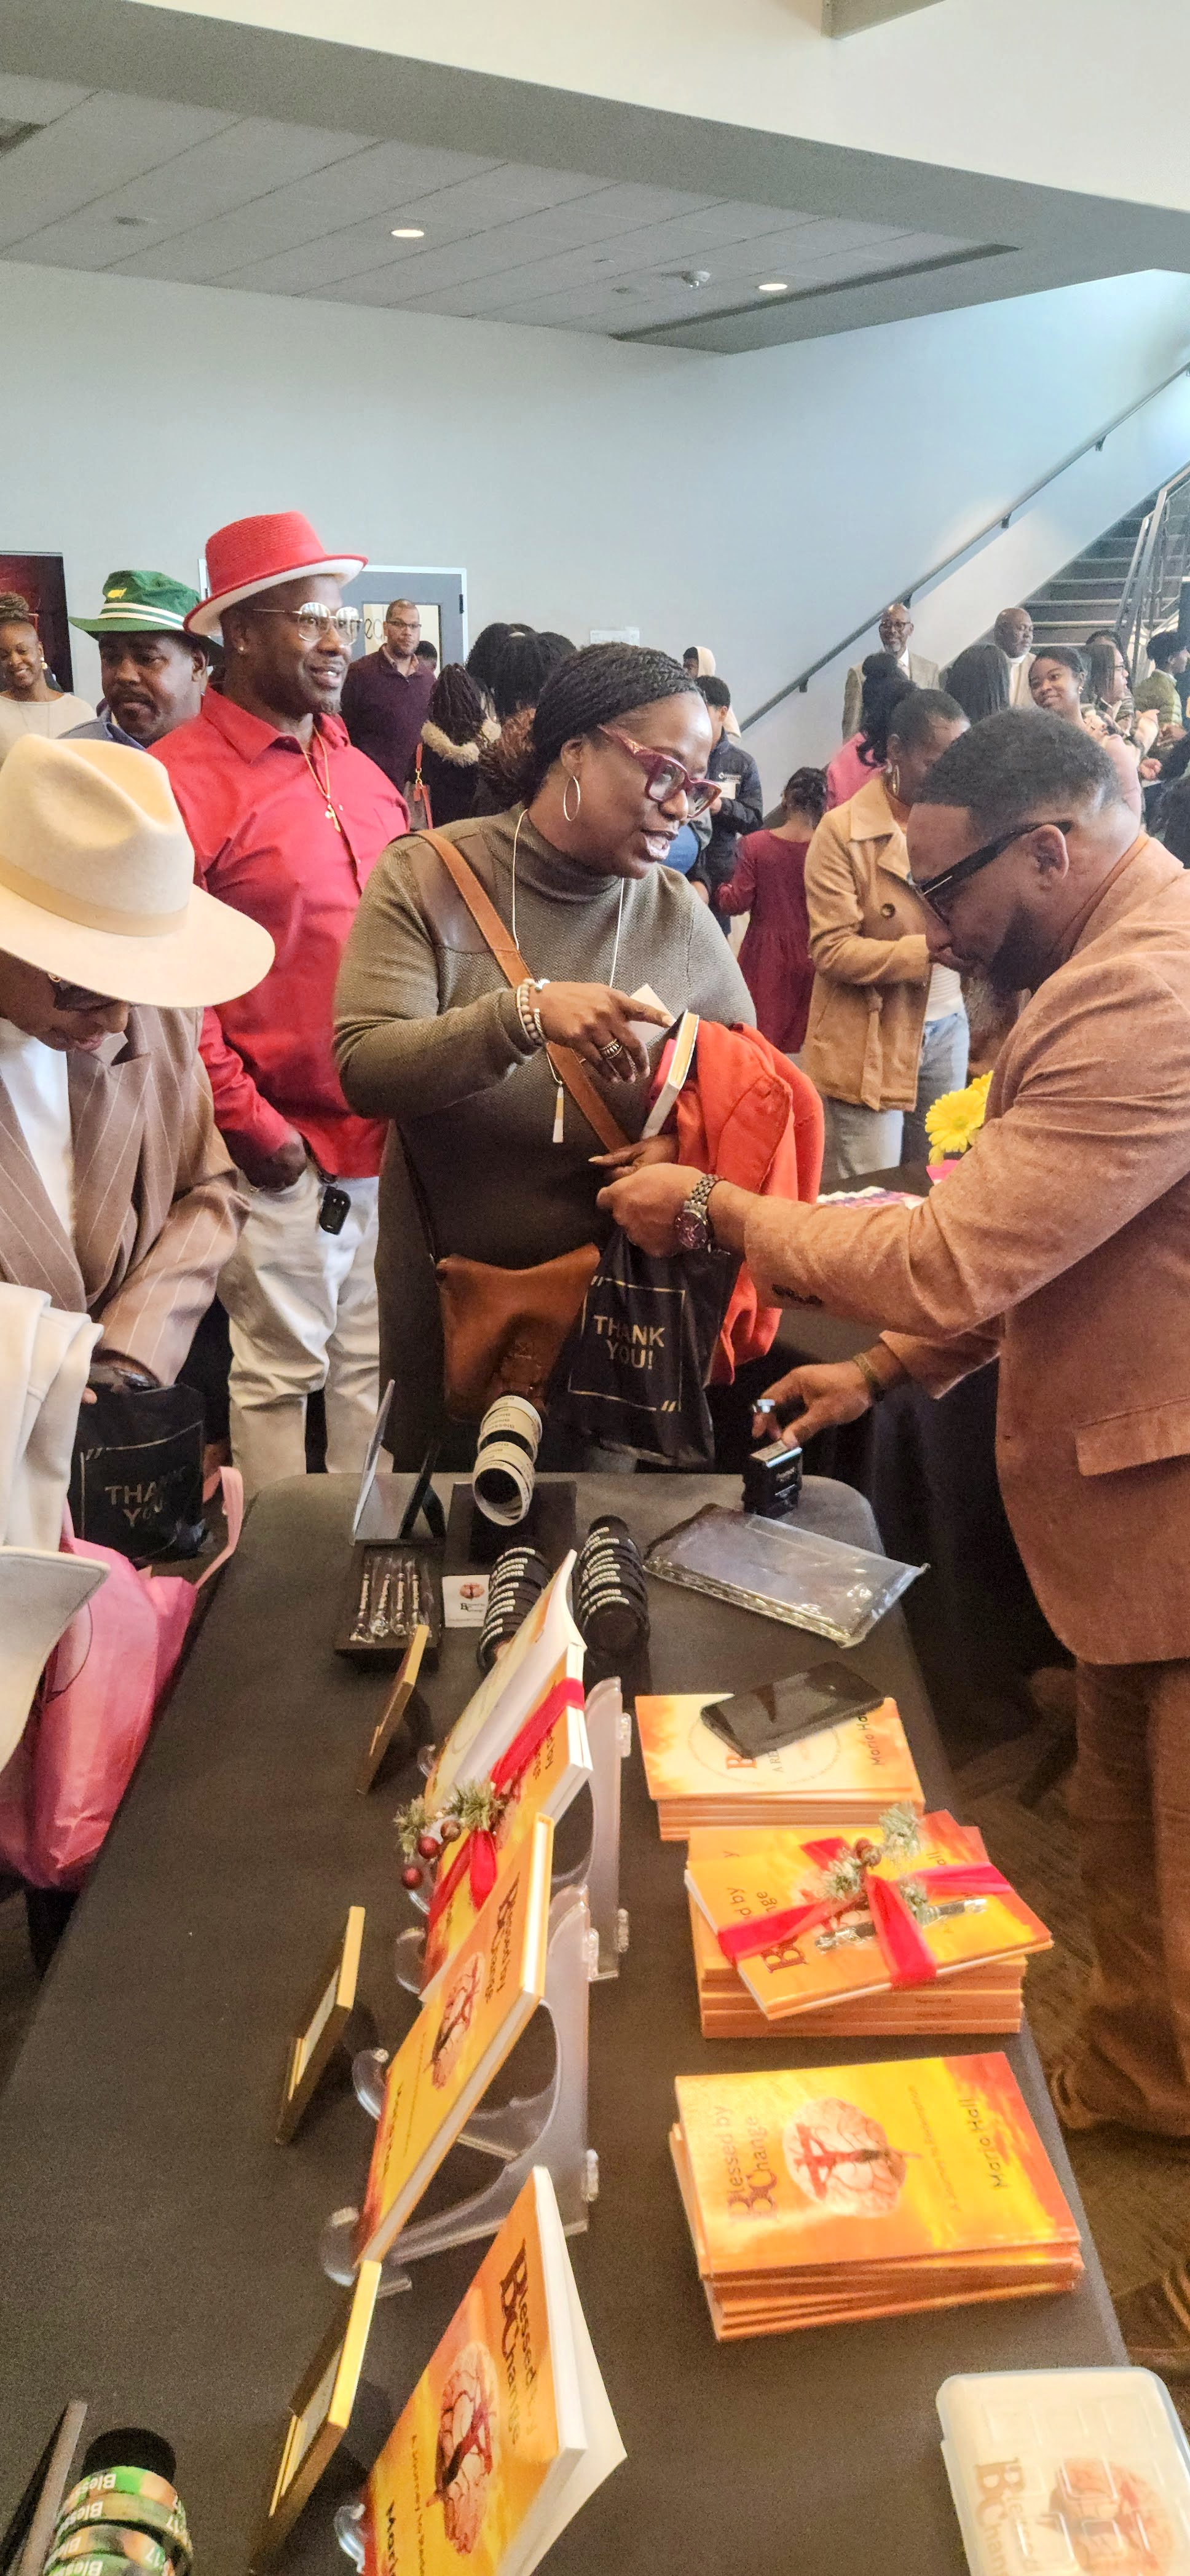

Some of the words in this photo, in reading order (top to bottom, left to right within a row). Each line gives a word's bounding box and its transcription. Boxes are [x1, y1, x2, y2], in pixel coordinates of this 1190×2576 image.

[594, 1315, 665, 1348] THANK
[606, 1340, 653, 1370] YOU!
[856, 1714, 870, 1732] Ha
[865, 1734, 885, 1766] Mario
[926, 1851, 947, 1866] all
[728, 1887, 746, 1905] by
[958, 2097, 985, 2133] Hall
[746, 2115, 778, 2198] Change
[979, 2137, 1007, 2189] Mario
[499, 2237, 537, 2390] Blessed
[501, 2306, 520, 2445] Change
[975, 2494, 1010, 2576] Chan
